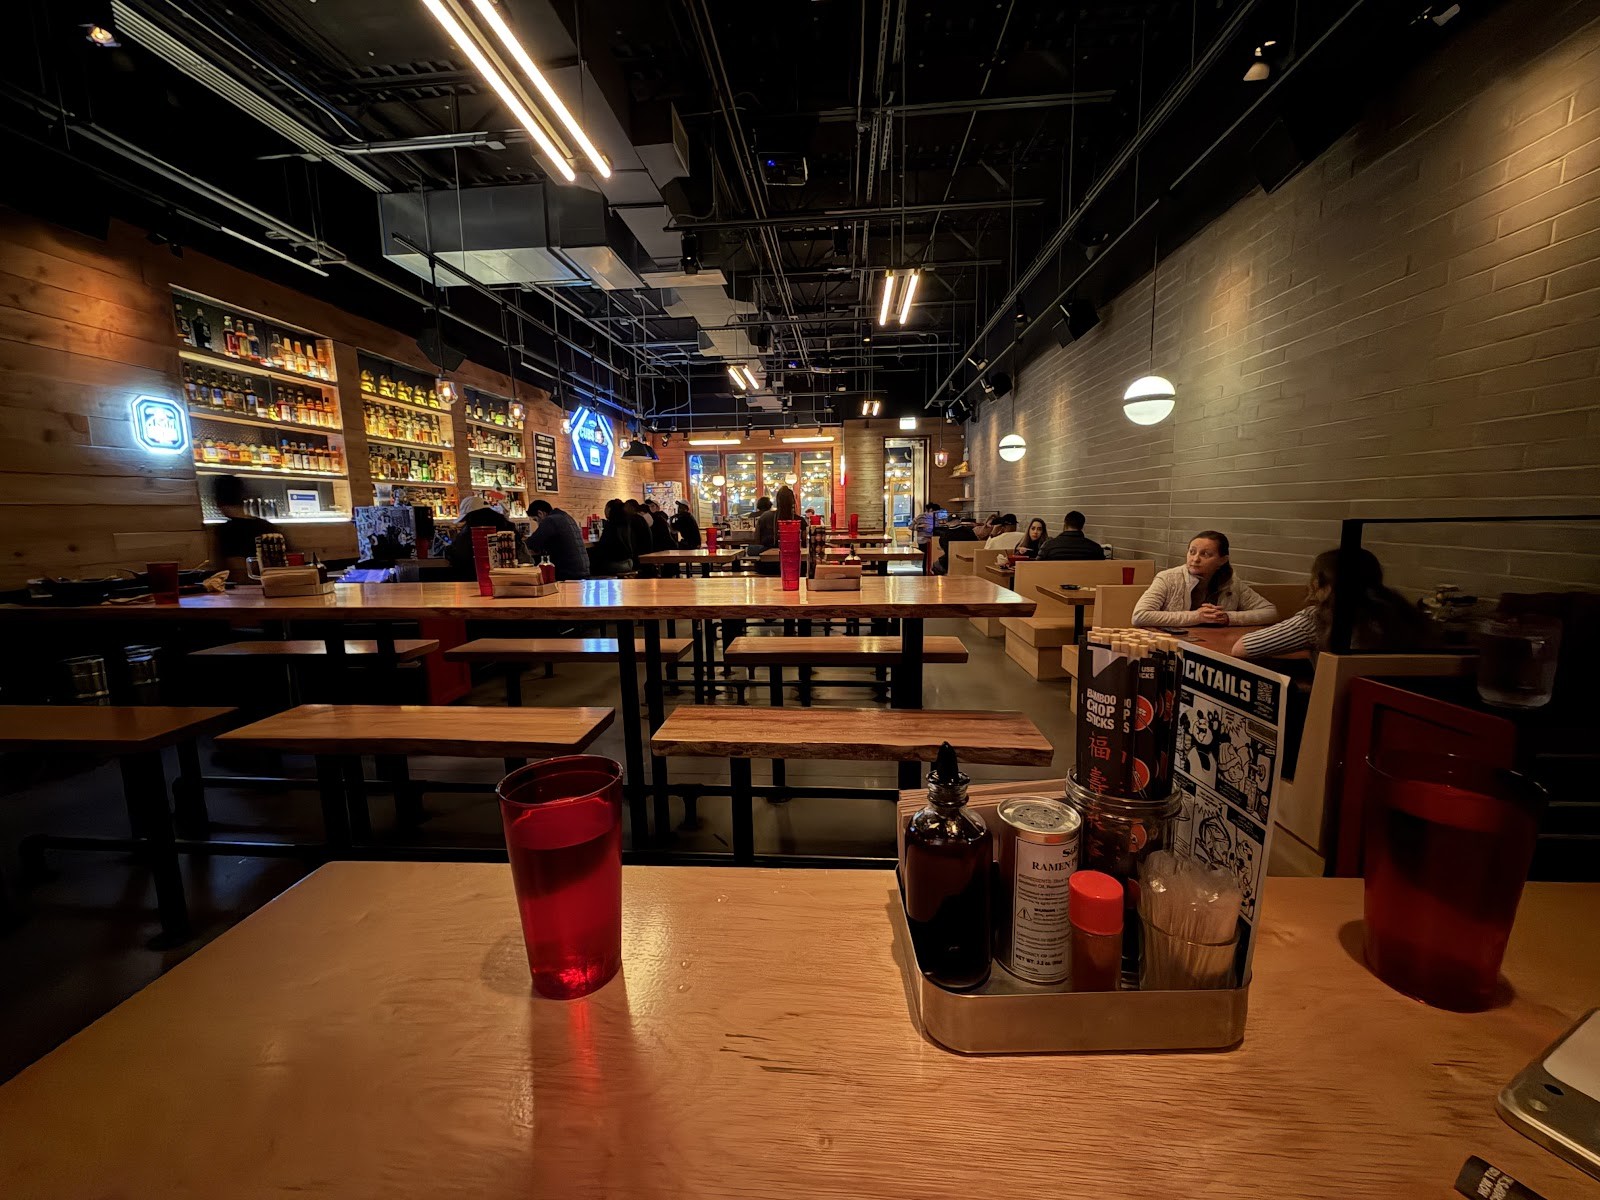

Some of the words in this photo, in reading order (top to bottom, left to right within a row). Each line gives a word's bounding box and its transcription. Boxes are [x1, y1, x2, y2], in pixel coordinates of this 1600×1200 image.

[1182, 658, 1251, 702] CKTAILS
[1086, 688, 1117, 705] BAMBOO
[1086, 699, 1115, 718] CHOP
[1086, 712, 1115, 730] STICKS
[1032, 860, 1071, 872] RAMEN
